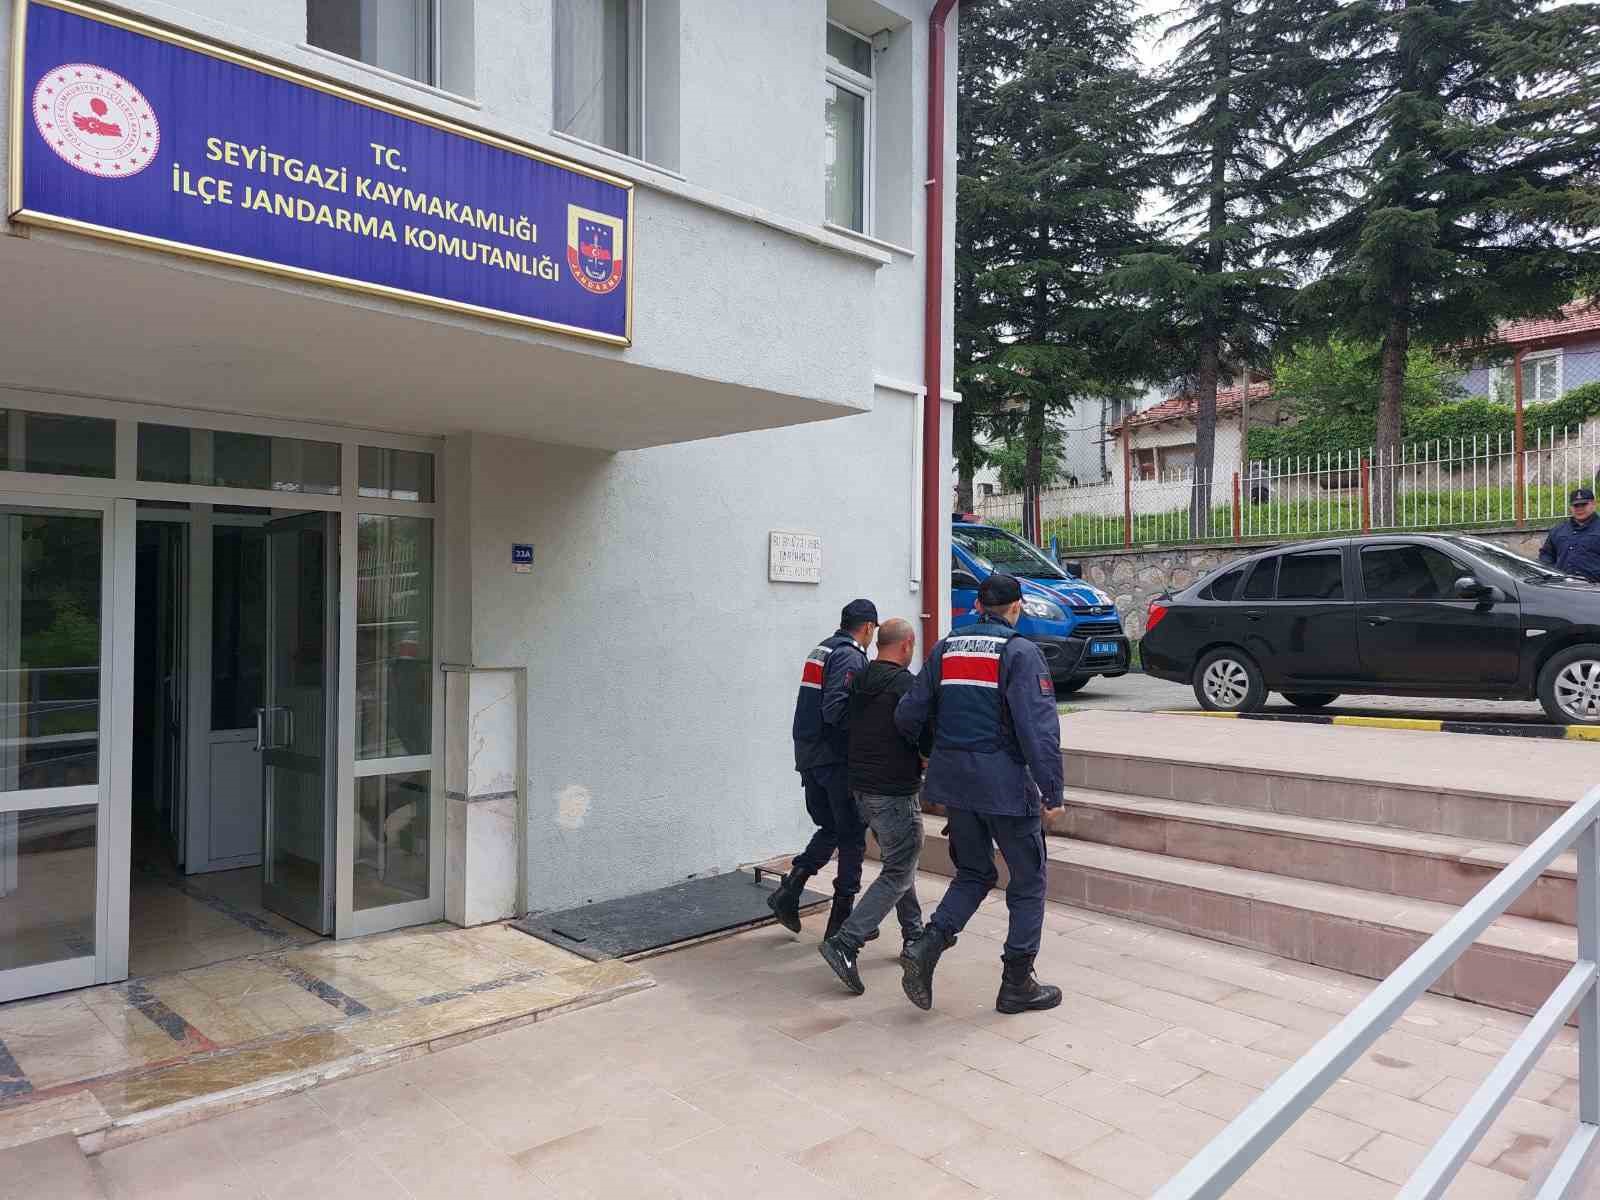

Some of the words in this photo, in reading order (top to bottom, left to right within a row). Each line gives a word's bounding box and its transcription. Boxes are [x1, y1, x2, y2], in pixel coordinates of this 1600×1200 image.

[206, 137, 347, 194] SEYİTGAZİ
[356, 175, 538, 244] KAYMAKAMLIĞI
[370, 142, 407, 173] TC.
[173, 162, 233, 206] İLÇE
[240, 186, 398, 243] JANDARMA
[404, 224, 561, 282] KOMUTANLIĞI
